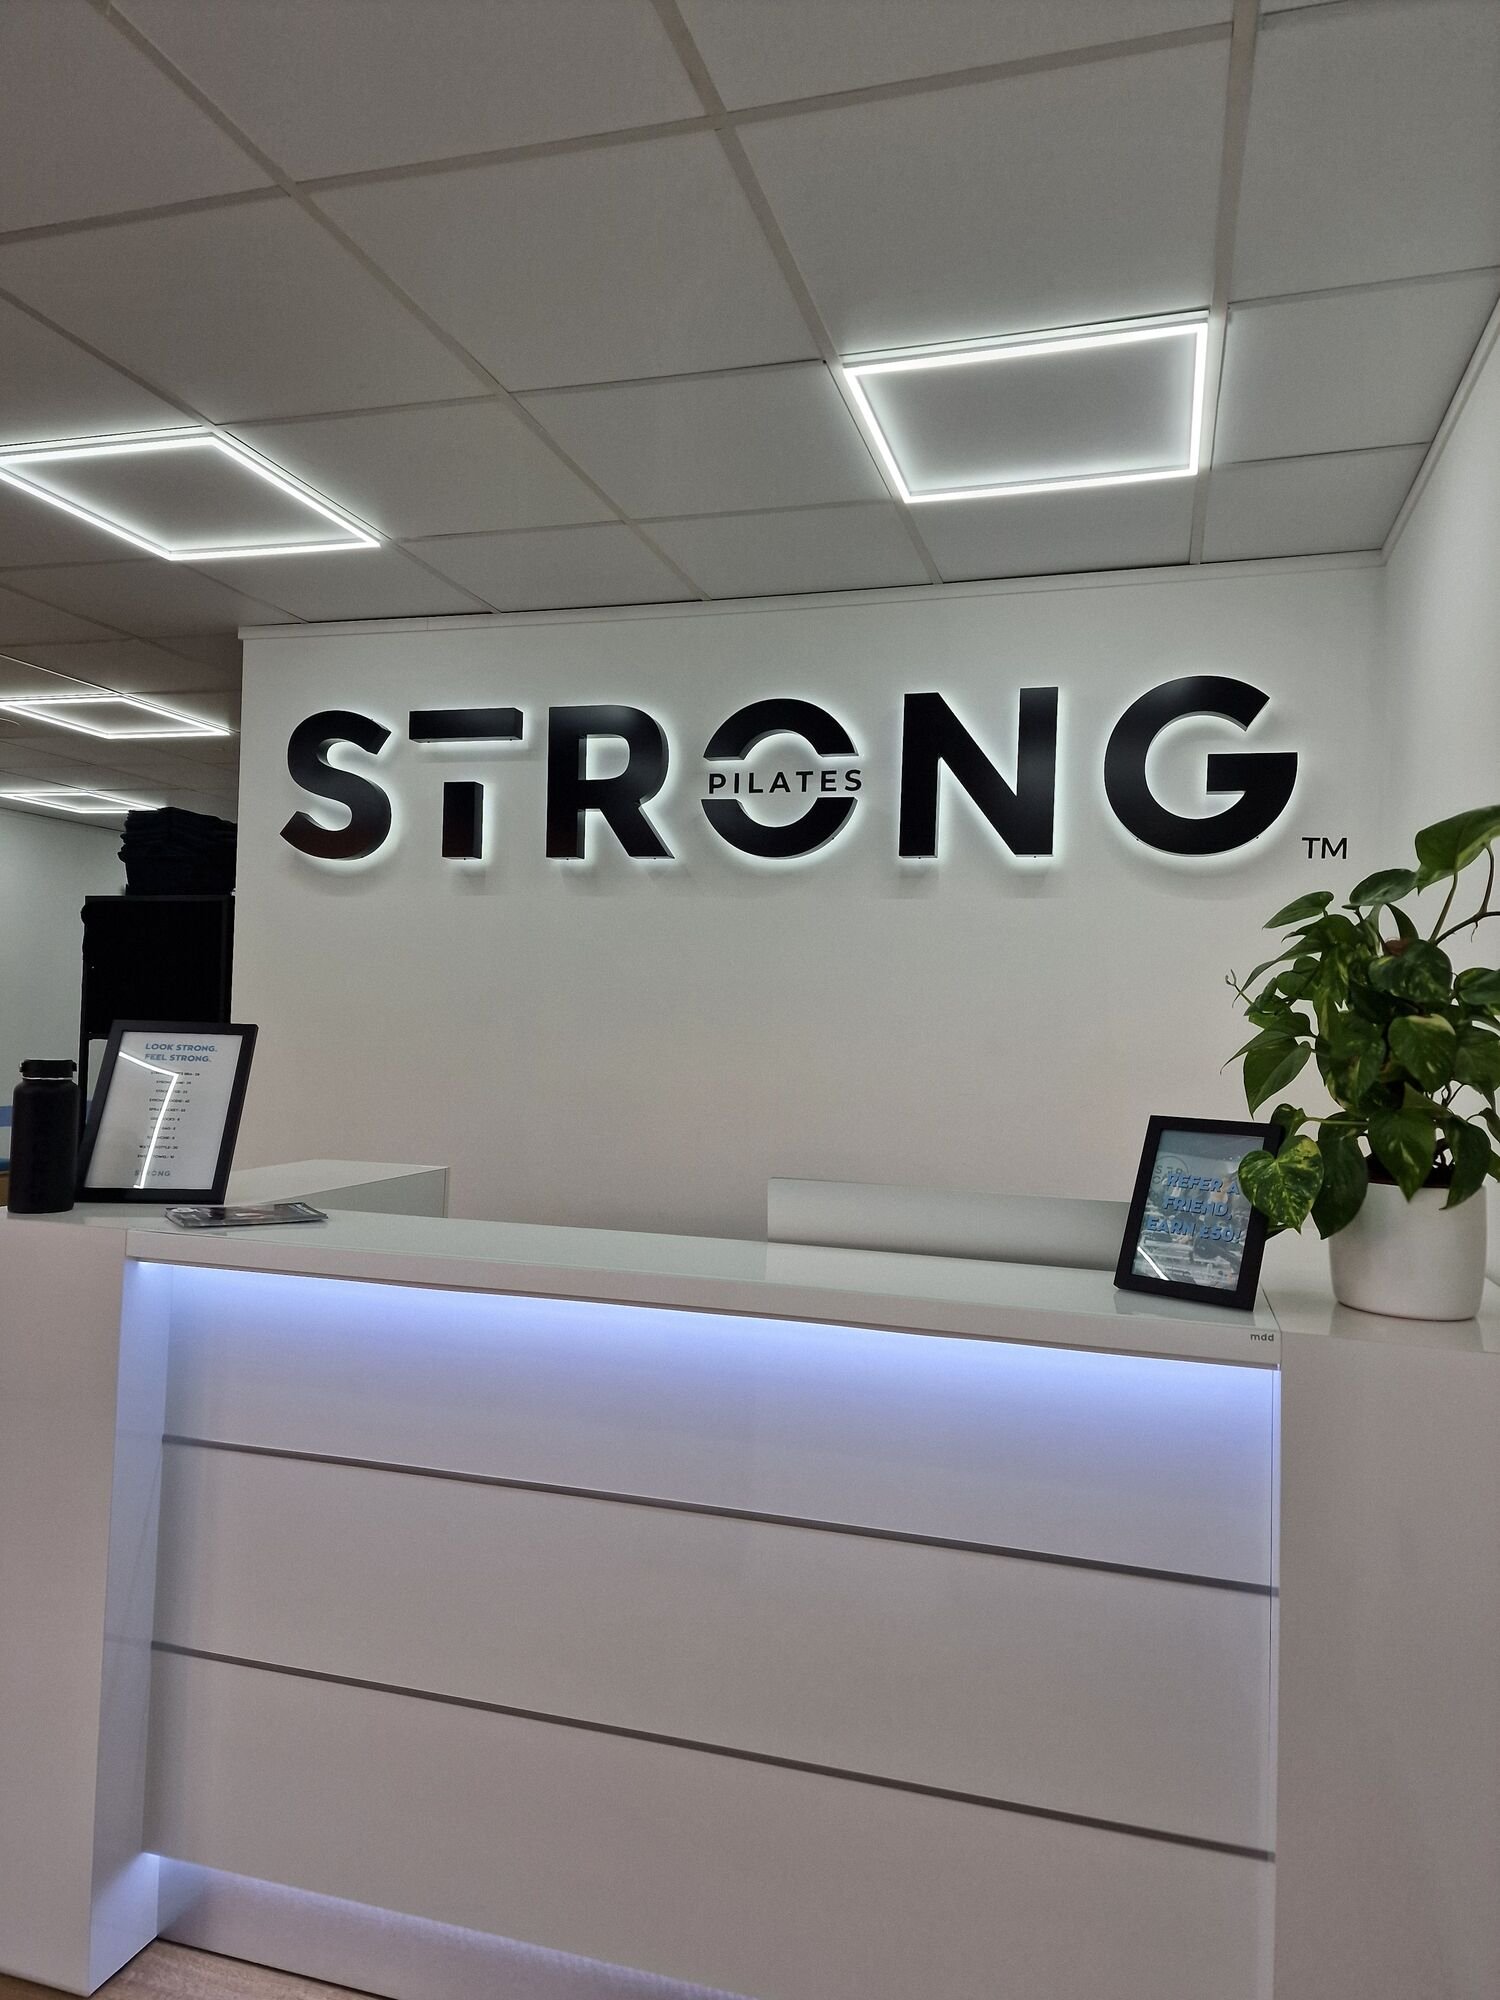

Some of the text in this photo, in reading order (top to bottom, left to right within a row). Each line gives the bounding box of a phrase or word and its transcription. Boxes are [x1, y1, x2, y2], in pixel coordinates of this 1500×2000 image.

[280, 675, 1347, 860] STRONG TM
[708, 769, 862, 795] PILATES
[144, 1053, 212, 1063] FEEL STRONG.
[145, 1043, 217, 1053] LOOK STRONG.
[1166, 1172, 1223, 1192] REFER
[1226, 1178, 1240, 1195] A
[1162, 1196, 1232, 1221] FRIEND,
[1146, 1216, 1197, 1237] EARN
[1250, 1333, 1275, 1342] mdd
